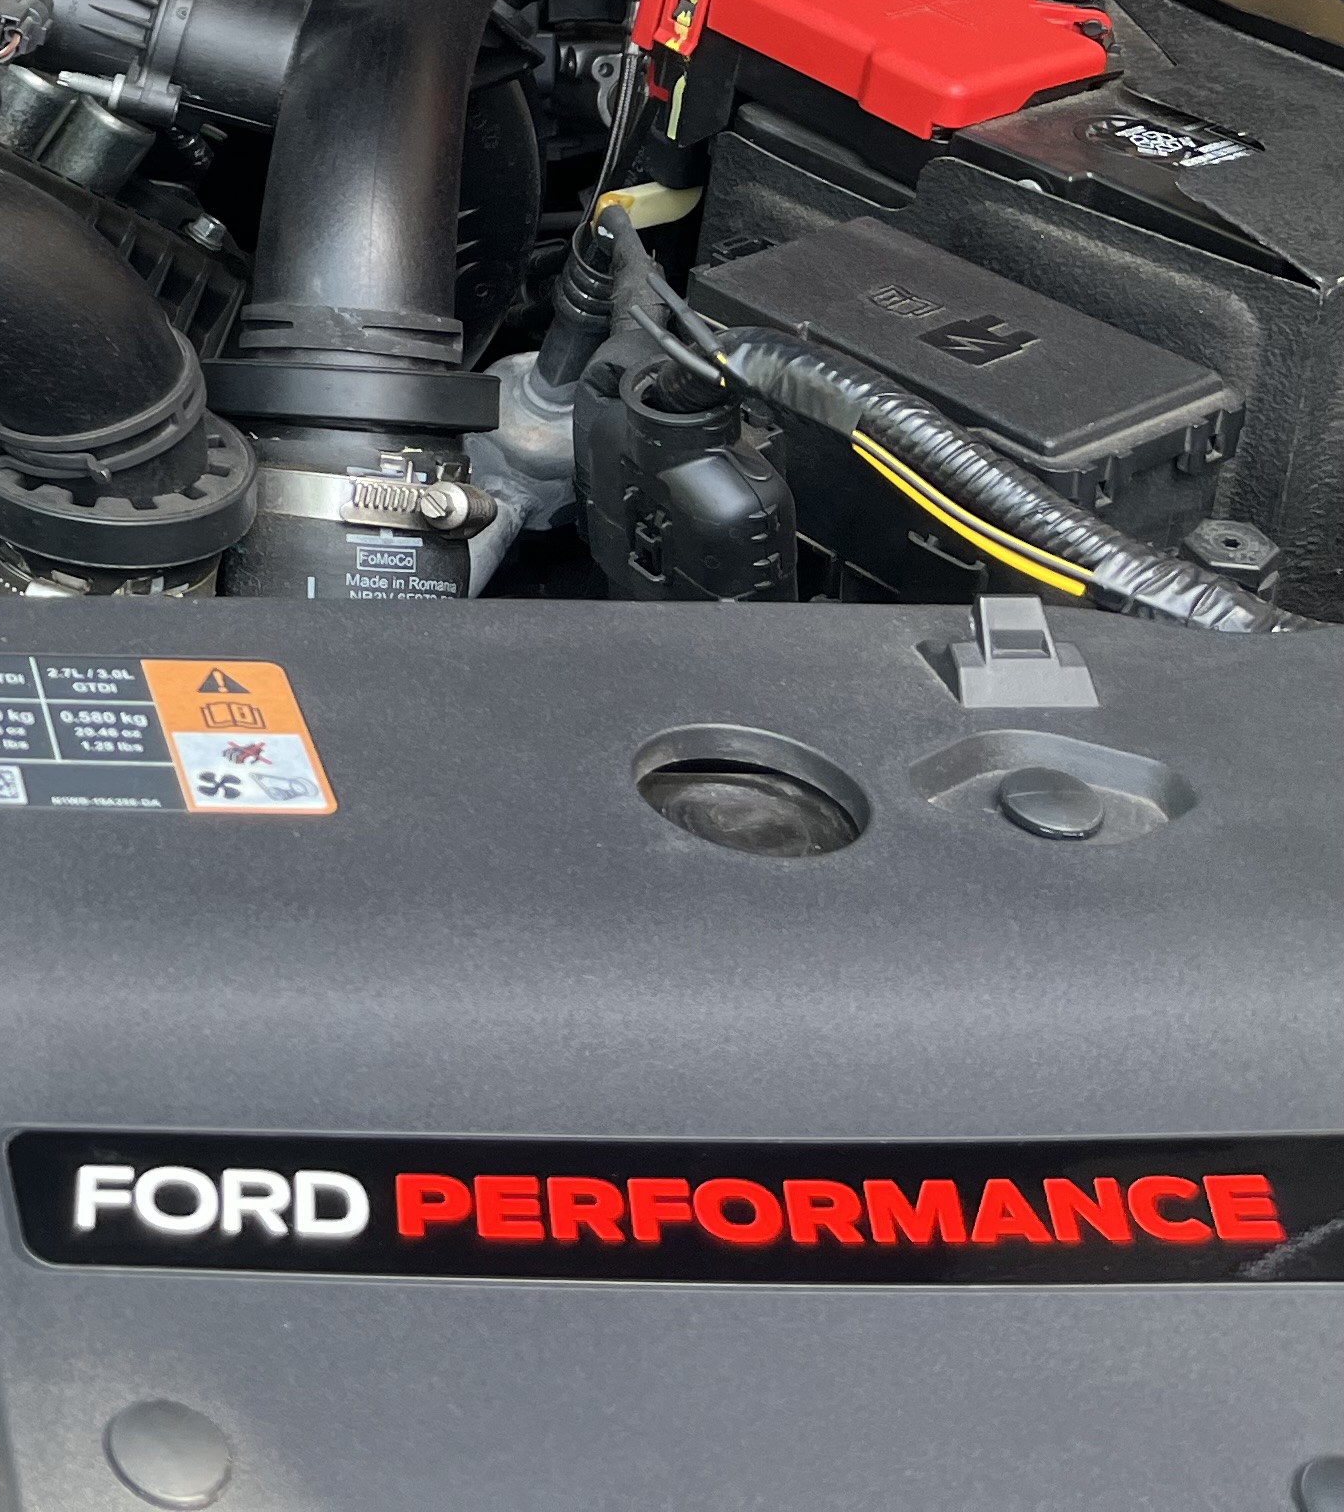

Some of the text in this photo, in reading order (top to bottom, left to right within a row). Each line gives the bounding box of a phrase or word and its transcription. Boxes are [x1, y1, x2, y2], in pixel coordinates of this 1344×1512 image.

[359, 551, 413, 567] FoMoCo
[345, 572, 457, 594] Made in Romania
[46, 667, 86, 681] 2.7L
[96, 668, 136, 681] 3.0L
[72, 681, 119, 695] GTDI
[7, 709, 36, 726] kg
[59, 710, 149, 728] 0.580 kg
[5, 726, 28, 737] oz
[73, 726, 143, 739] 20.46 oz
[1, 738, 30, 751] lbs
[80, 740, 145, 753] 1.28 lbs
[74, 1164, 1285, 1245] FORD PERFORMANCE
